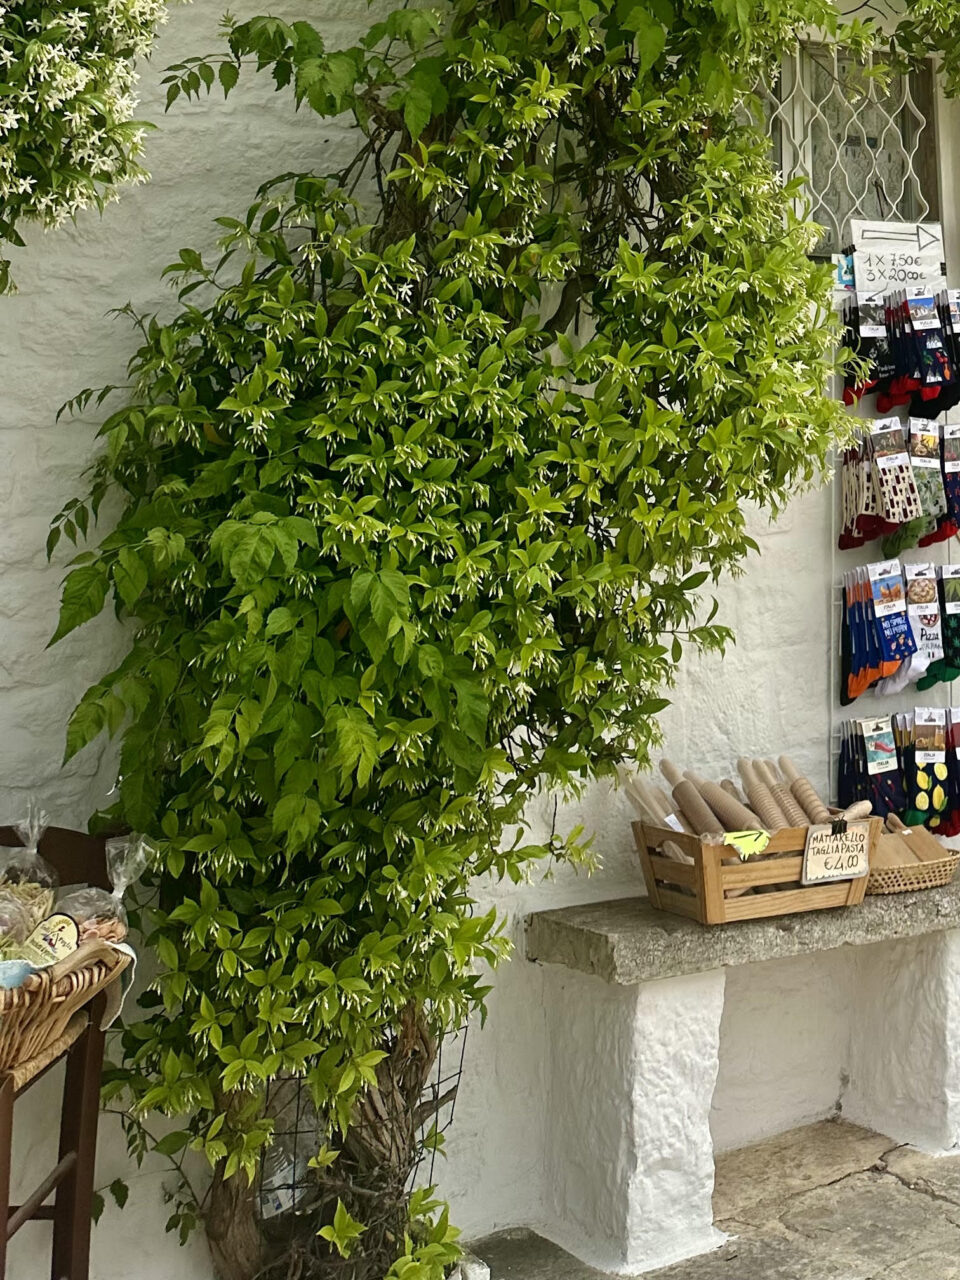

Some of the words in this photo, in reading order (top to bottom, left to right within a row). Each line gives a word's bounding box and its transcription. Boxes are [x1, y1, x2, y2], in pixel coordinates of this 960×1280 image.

[864, 253, 871, 267] 1
[866, 269, 876, 281] 3
[881, 621, 891, 630] NO
[884, 628, 893, 638] NO
[920, 628, 940, 641] Pizza
